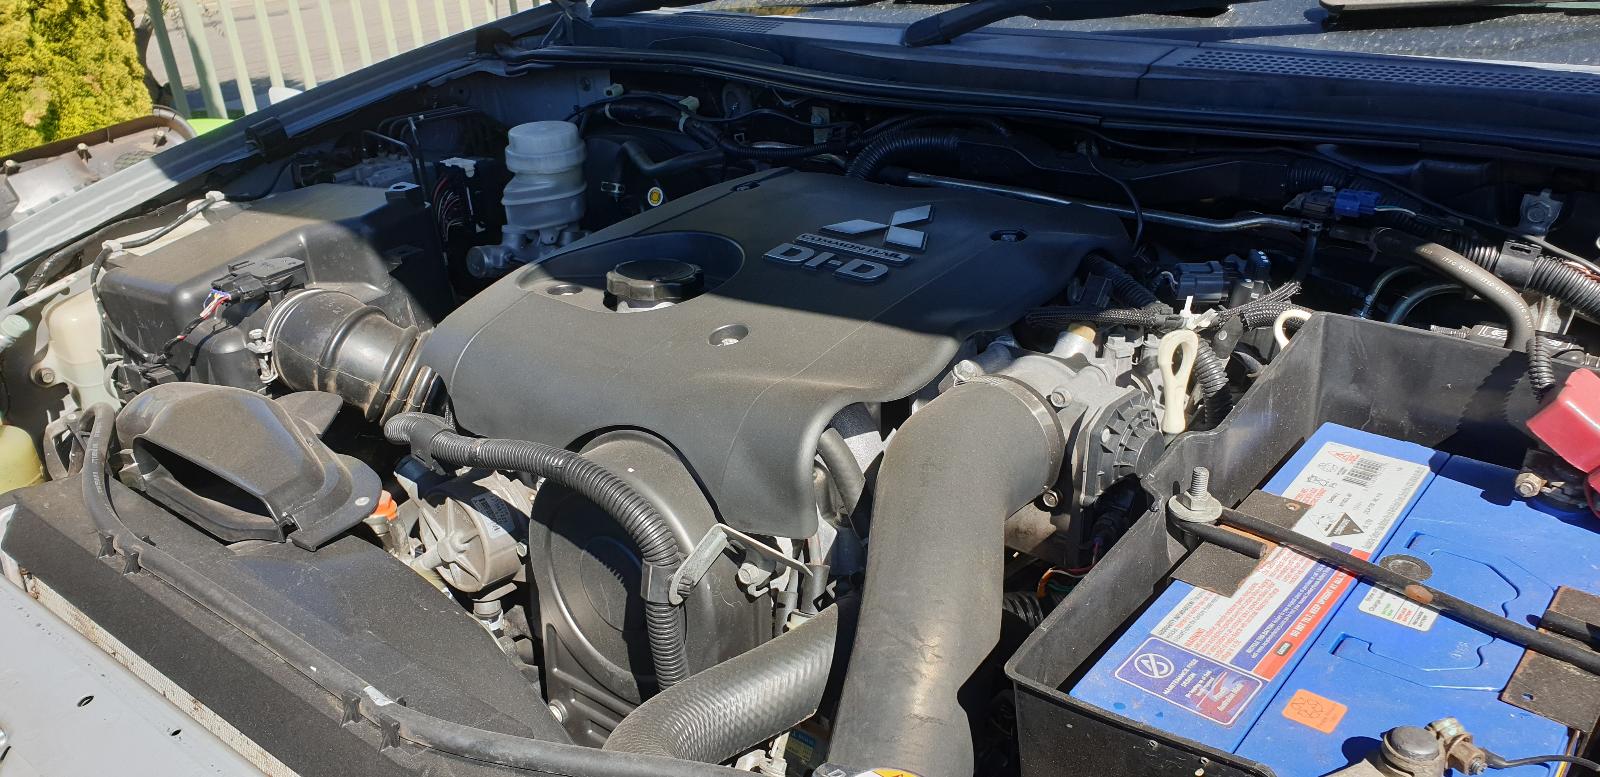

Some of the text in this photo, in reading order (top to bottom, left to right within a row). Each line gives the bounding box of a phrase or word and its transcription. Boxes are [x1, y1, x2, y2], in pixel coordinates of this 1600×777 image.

[762, 242, 889, 281] DI-D
[801, 233, 902, 260] COMMON RAIL
